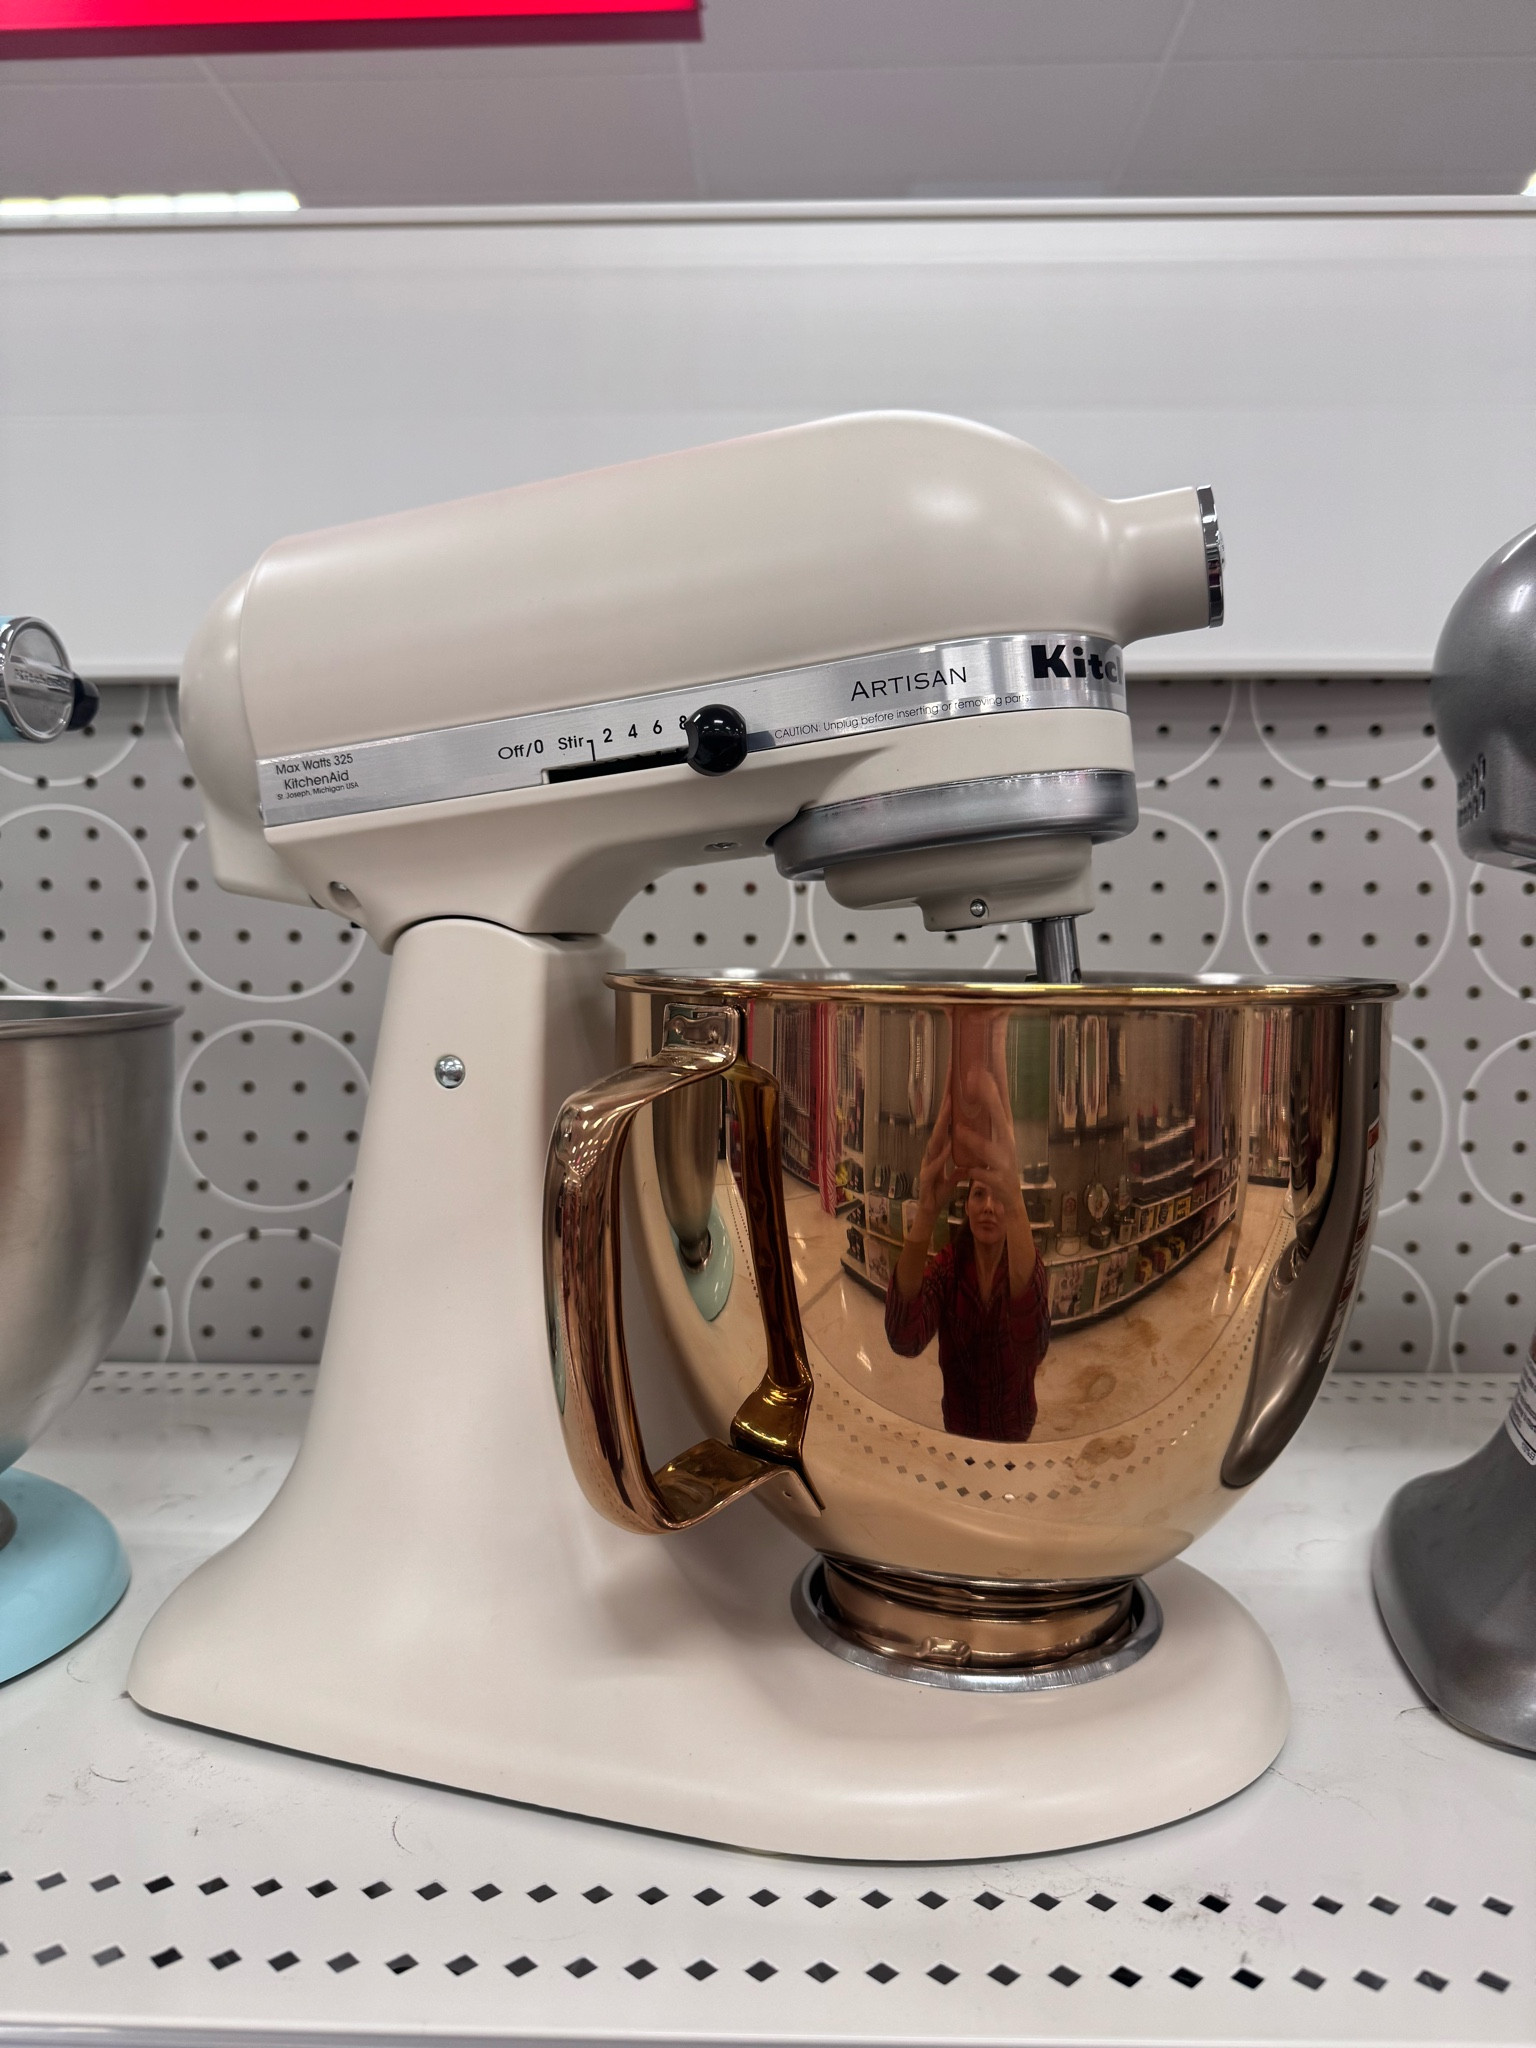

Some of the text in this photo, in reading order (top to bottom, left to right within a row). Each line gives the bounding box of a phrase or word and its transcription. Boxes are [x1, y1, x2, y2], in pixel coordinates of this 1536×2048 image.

[851, 666, 967, 702] ARTISAN
[774, 724, 820, 739] CAUTION:
[823, 718, 859, 732] Unplug
[860, 711, 894, 725] before
[896, 704, 939, 719] inserting
[941, 702, 952, 712] or
[954, 696, 1002, 710] removing
[558, 735, 584, 750] Stir
[602, 728, 613, 743] 2
[628, 723, 638, 738] 4
[652, 720, 663, 734] 6
[679, 715, 687, 730] 8
[275, 753, 354, 775] Max Watts 325
[284, 770, 349, 790] KitchenAid
[312, 784, 345, 793] Michigan
[346, 781, 359, 790] USA
